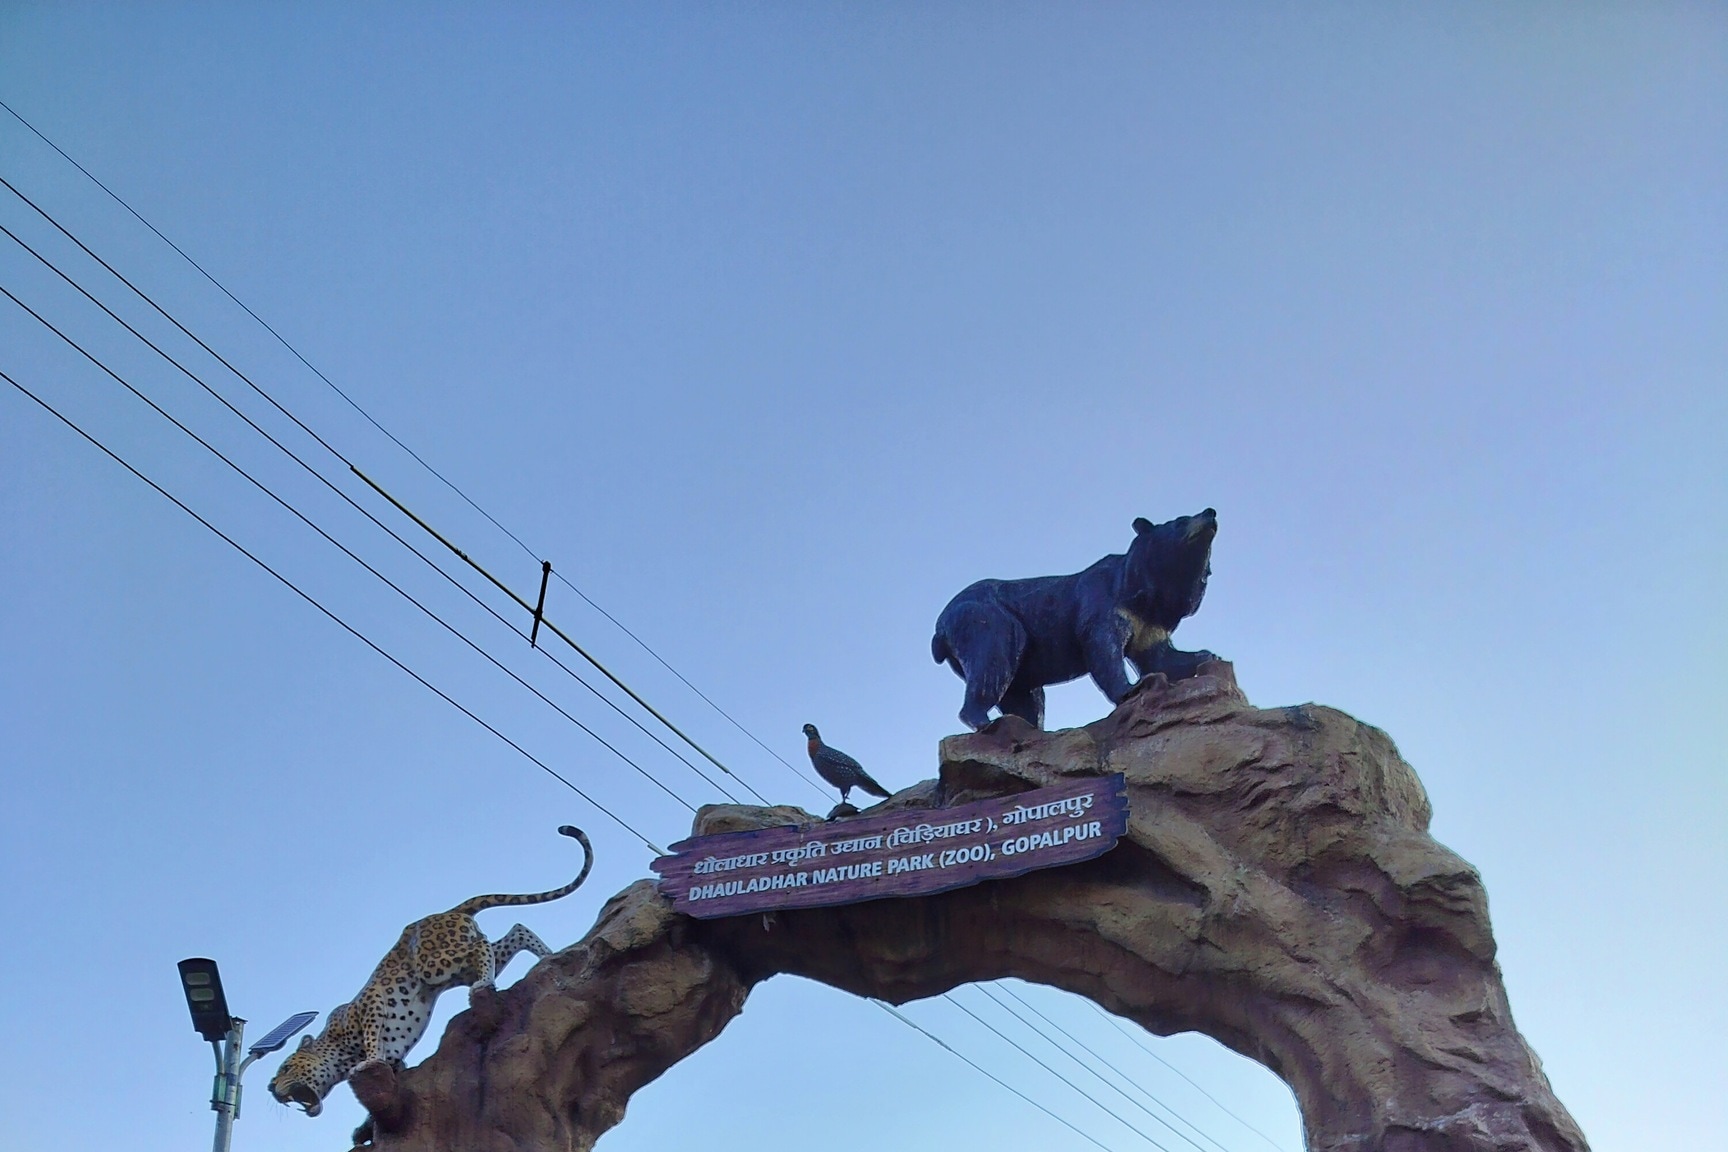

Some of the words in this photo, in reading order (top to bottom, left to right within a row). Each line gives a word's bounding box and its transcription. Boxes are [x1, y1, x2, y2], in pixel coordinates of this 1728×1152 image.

[688, 871, 808, 902] DHAULADHAR
[812, 861, 882, 885] NATURE
[887, 853, 934, 875] PARK
[939, 843, 995, 869] (ZOO),
[1001, 821, 1102, 855] GOPALPUR
[694, 852, 770, 874] धौलाधार
[771, 843, 826, 867] प्रकृति
[831, 834, 882, 856] उद्यान
[1002, 793, 1095, 825] गोपालपुर
